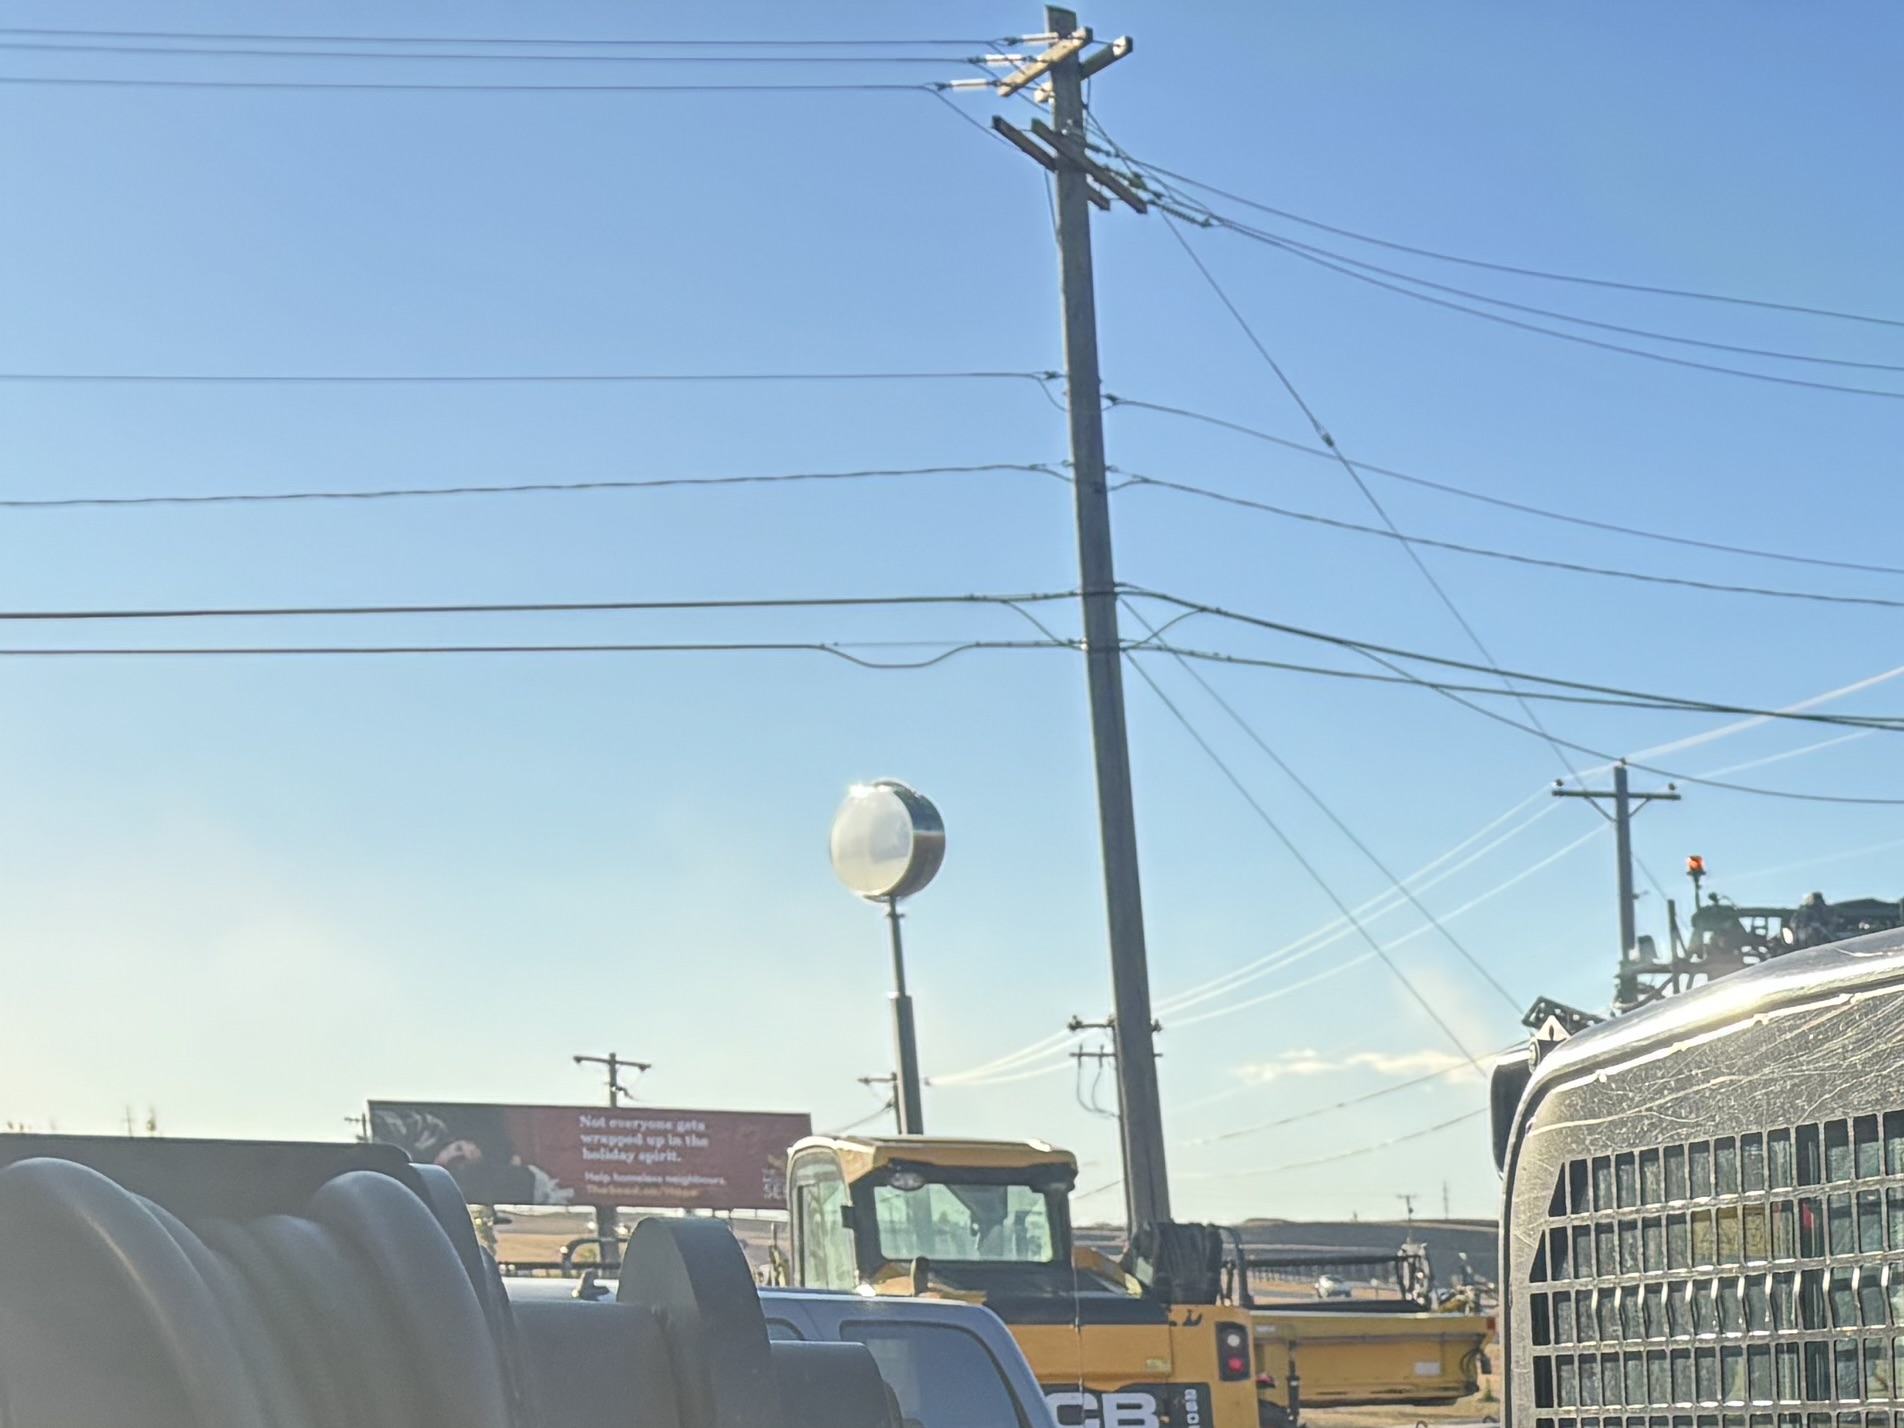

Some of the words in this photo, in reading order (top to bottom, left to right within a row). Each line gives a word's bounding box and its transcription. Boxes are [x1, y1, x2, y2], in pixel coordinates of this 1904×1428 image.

[579, 1114, 606, 1128] Not
[609, 1118, 673, 1132] everyone
[676, 1120, 706, 1132] gets
[580, 1133, 643, 1148] wrapped
[646, 1137, 665, 1149] up
[667, 1134, 683, 1147] in
[684, 1135, 709, 1148] the
[582, 1147, 635, 1163] holiday
[637, 1149, 682, 1164] spirit.
